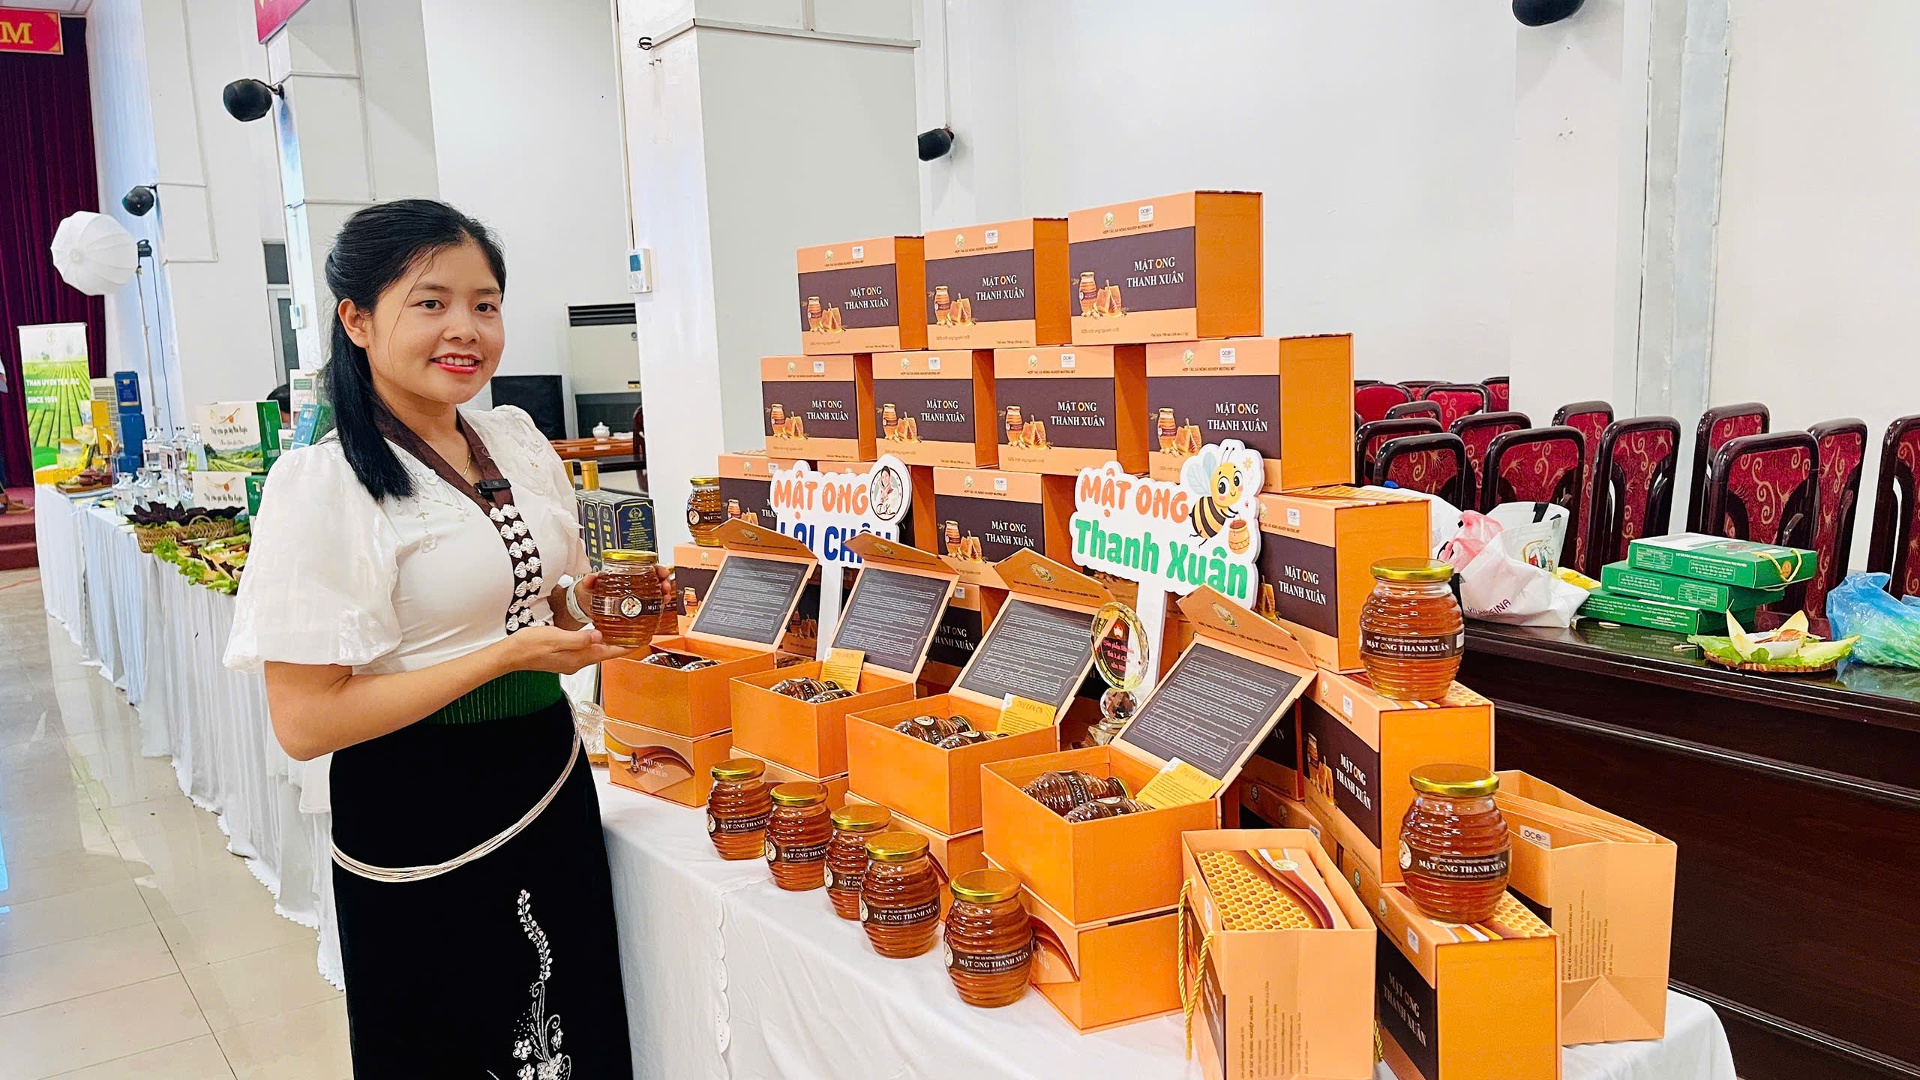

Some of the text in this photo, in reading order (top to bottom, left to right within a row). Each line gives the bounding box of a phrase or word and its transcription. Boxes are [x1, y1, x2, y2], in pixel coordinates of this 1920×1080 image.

[1134, 256, 1176, 272] MẬT ONG
[982, 274, 1017, 288] MẬT ONG
[1126, 270, 1184, 288] THANH XUÂN
[850, 286, 882, 298] MẬT ONG
[976, 287, 1025, 301] THANH XUÂN
[844, 298, 889, 310] THANH XUÂN
[812, 399, 843, 410] MẬT ONG
[926, 399, 959, 410] MẬT ONG
[1057, 400, 1097, 413] MẬT ONG
[1215, 402, 1259, 416] MẬT ONG
[806, 410, 849, 421] THANH XUÂN
[920, 411, 966, 423] THANH XUÂN
[1050, 415, 1105, 427] THANH XUÂN
[1207, 418, 1268, 432] THANH XUÂN
[773, 470, 868, 519] MẬT ONG
[1080, 467, 1189, 524] MẬT ONG
[991, 520, 1027, 533] MẬT ONG
[985, 532, 1035, 547] THANH XUÂN
[1075, 518, 1248, 599] Thanh Xuân
[1284, 564, 1319, 585] MẬT ONG
[1278, 580, 1327, 606] THANH XUÂN
[1366, 639, 1379, 649] MẬT
[1380, 643, 1397, 651] ONG
[1429, 642, 1450, 652] XUÂN
[1418, 859, 1437, 871] MẬT
[1437, 864, 1458, 873] ONG
[1460, 865, 1490, 873] THANH
[873, 912, 886, 921] MẬT
[958, 958, 973, 968] MẬT
